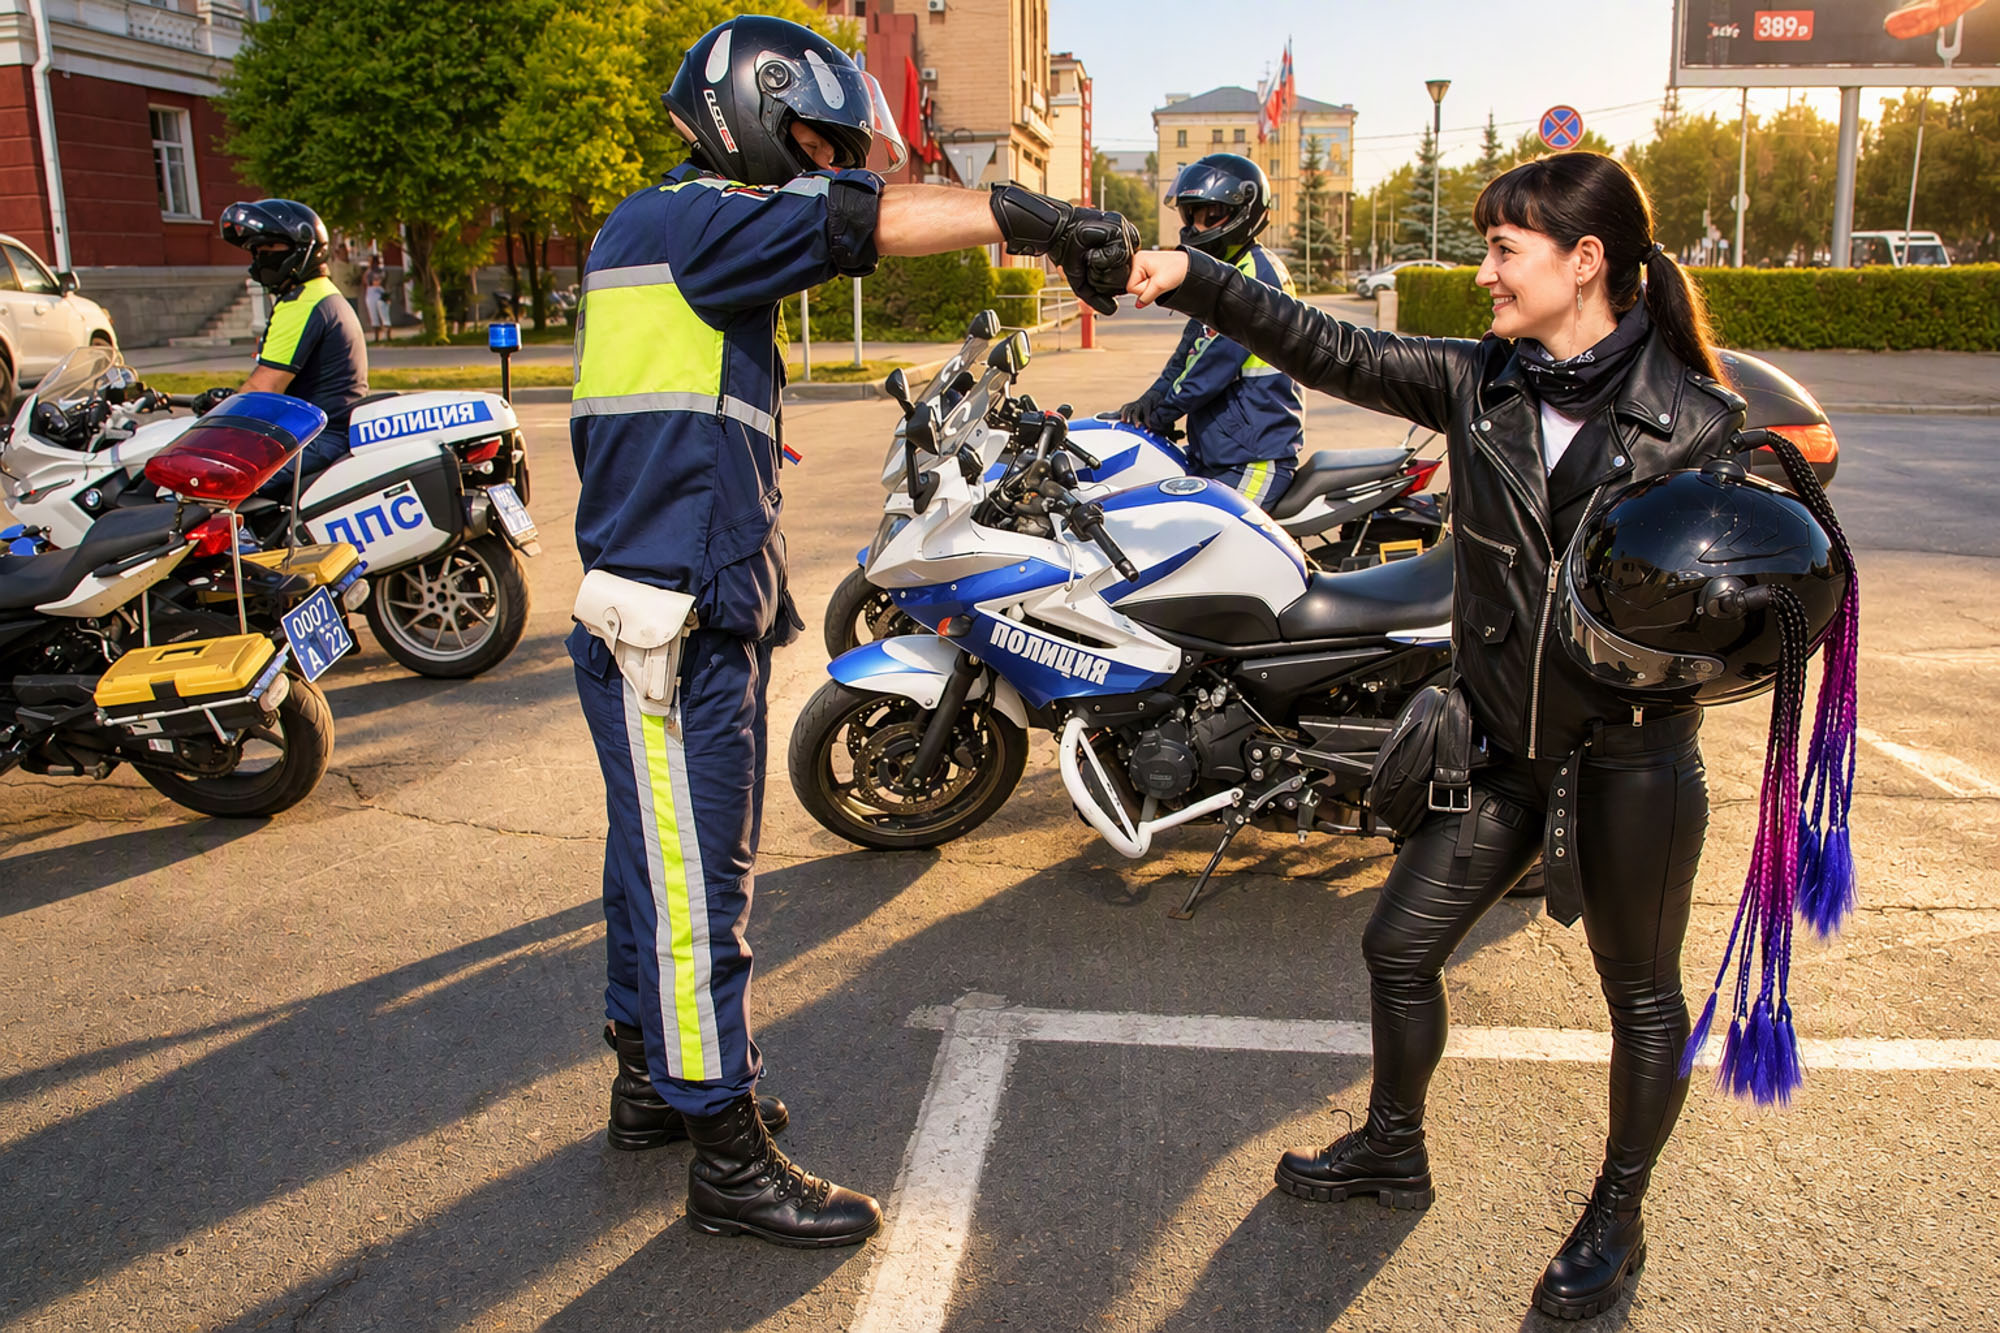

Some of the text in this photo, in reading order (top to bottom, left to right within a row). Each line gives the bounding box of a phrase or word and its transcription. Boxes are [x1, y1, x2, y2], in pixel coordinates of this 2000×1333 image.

[358, 402, 476, 443] ПОЛИЦИЯ
[324, 495, 424, 554] ДПС
[292, 596, 329, 640] 0007
[325, 626, 349, 656] 22
[989, 621, 1111, 686] ПОЛИЦИЯ
